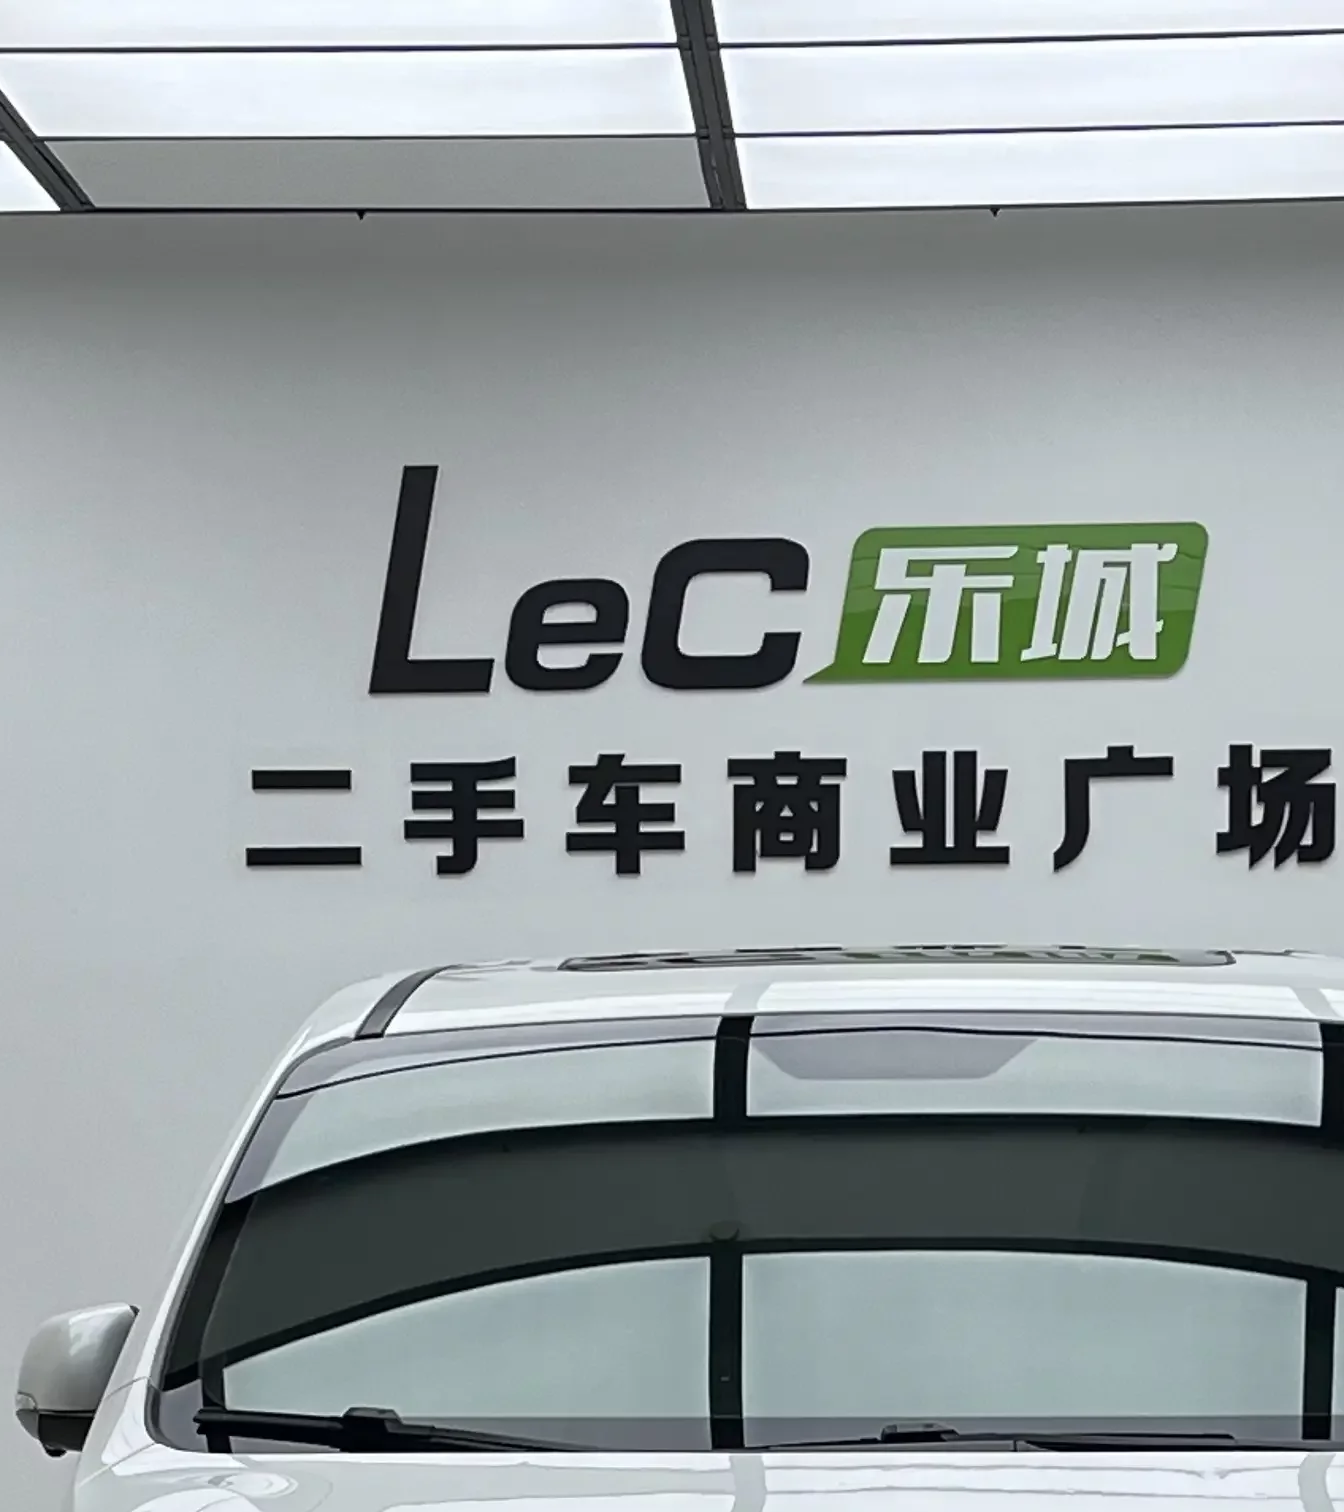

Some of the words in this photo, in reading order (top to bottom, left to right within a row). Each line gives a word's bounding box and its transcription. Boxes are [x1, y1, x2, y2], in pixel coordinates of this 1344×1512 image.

[368, 464, 809, 695] LeC
[861, 543, 1179, 664] 乐城
[244, 744, 1338, 876] 二手车商业广场
